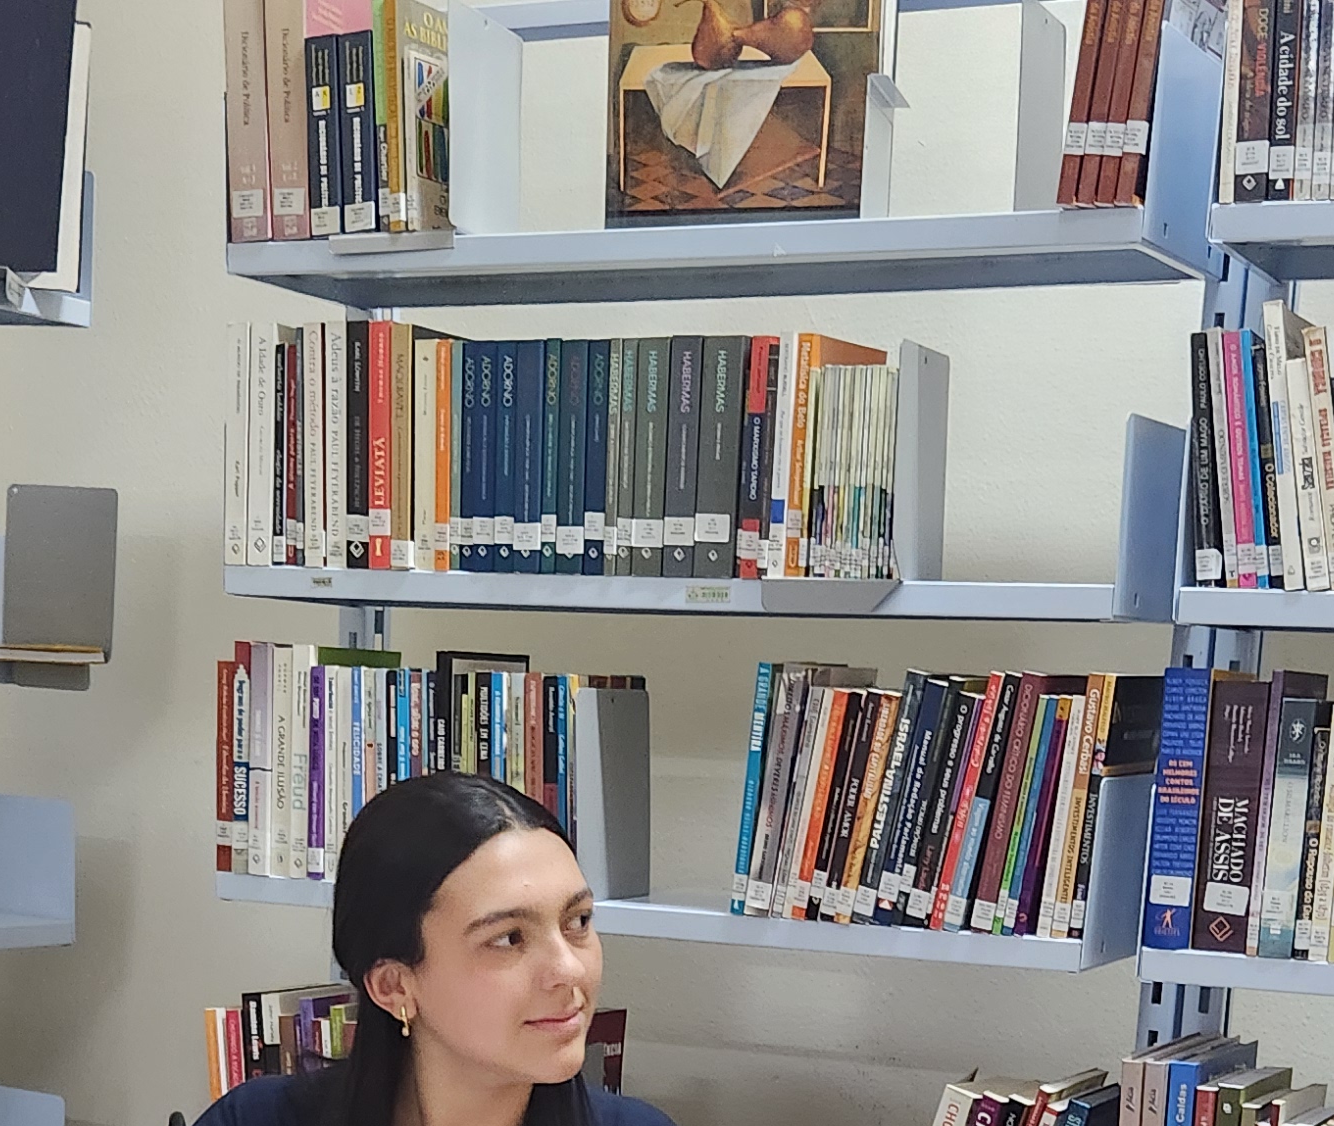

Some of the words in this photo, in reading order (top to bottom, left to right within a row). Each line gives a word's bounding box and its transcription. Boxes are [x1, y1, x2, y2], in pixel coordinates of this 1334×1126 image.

[1281, 31, 1292, 43] A
[1277, 46, 1294, 95] cidade
[1276, 97, 1293, 117] do
[1275, 118, 1291, 140] sol
[380, 143, 390, 181] Chartier
[257, 336, 267, 345] A
[309, 330, 319, 374] Contra
[331, 332, 342, 372] Adeus
[257, 348, 267, 374] Idade
[479, 355, 492, 407] ADORNO
[501, 355, 514, 407] ADORNO
[546, 353, 558, 405] ADORNO
[713, 349, 727, 413] HABERMAS
[257, 376, 267, 388] de
[309, 377, 319, 387] o
[463, 357, 476, 408] ADORNO
[608, 353, 620, 415] HABERMAS
[621, 350, 634, 413] HABERMAS
[646, 350, 659, 413] HABERMAS
[679, 350, 692, 414] HABERMAS
[257, 390, 267, 416] Ouro
[309, 390, 319, 437] método
[331, 388, 342, 424] razão
[752, 416, 761, 424] O
[331, 430, 342, 457] PAUL
[750, 425, 761, 470] MARXISMO
[1198, 417, 1209, 448] MAGO
[309, 442, 319, 464] PAUL
[373, 437, 385, 506] LEVIATÃ
[1199, 448, 1209, 464] UM
[1199, 465, 1209, 481] DE
[1263, 463, 1274, 472] O
[309, 468, 319, 531] FEYERABEND
[331, 461, 342, 537] FEYERABEND
[749, 470, 759, 501] TARDIO
[1264, 473, 1279, 538] Colecionador
[479, 686, 490, 725] MULTIDÕES
[754, 675, 768, 711] GRANDE
[960, 704, 968, 713] O
[1014, 684, 1034, 736] DICIONÁRIO
[1084, 688, 1100, 733] Gustavo
[277, 715, 286, 724] A
[479, 727, 489, 739] EM
[749, 711, 764, 752] MENTIRA
[948, 715, 966, 759] progresso
[277, 725, 286, 768] GRANDE
[352, 721, 362, 776] FELICIDADE
[479, 741, 489, 761] CENA
[891, 717, 911, 770] ISRAEL
[1007, 738, 1024, 773] CRÍTICO
[1078, 735, 1094, 775] Cerbasi
[234, 765, 248, 816] SUCESSO
[277, 771, 287, 809] ILUSÃO
[292, 753, 308, 811] Freud
[845, 778, 860, 806] PODER
[942, 768, 952, 788] seus
[1004, 774, 1015, 788] DO
[839, 811, 852, 839] AMOR
[870, 769, 897, 849] PALESTINA
[932, 789, 949, 834] problemas
[994, 790, 1013, 839] FEMINISMO
[1079, 792, 1099, 866] INVESTIMENTOS
[1216, 796, 1234, 824] DE
[1212, 828, 1231, 881] ASSIS
[1229, 797, 1251, 883] MACHADO
[1175, 1083, 1188, 1123] Caldas
